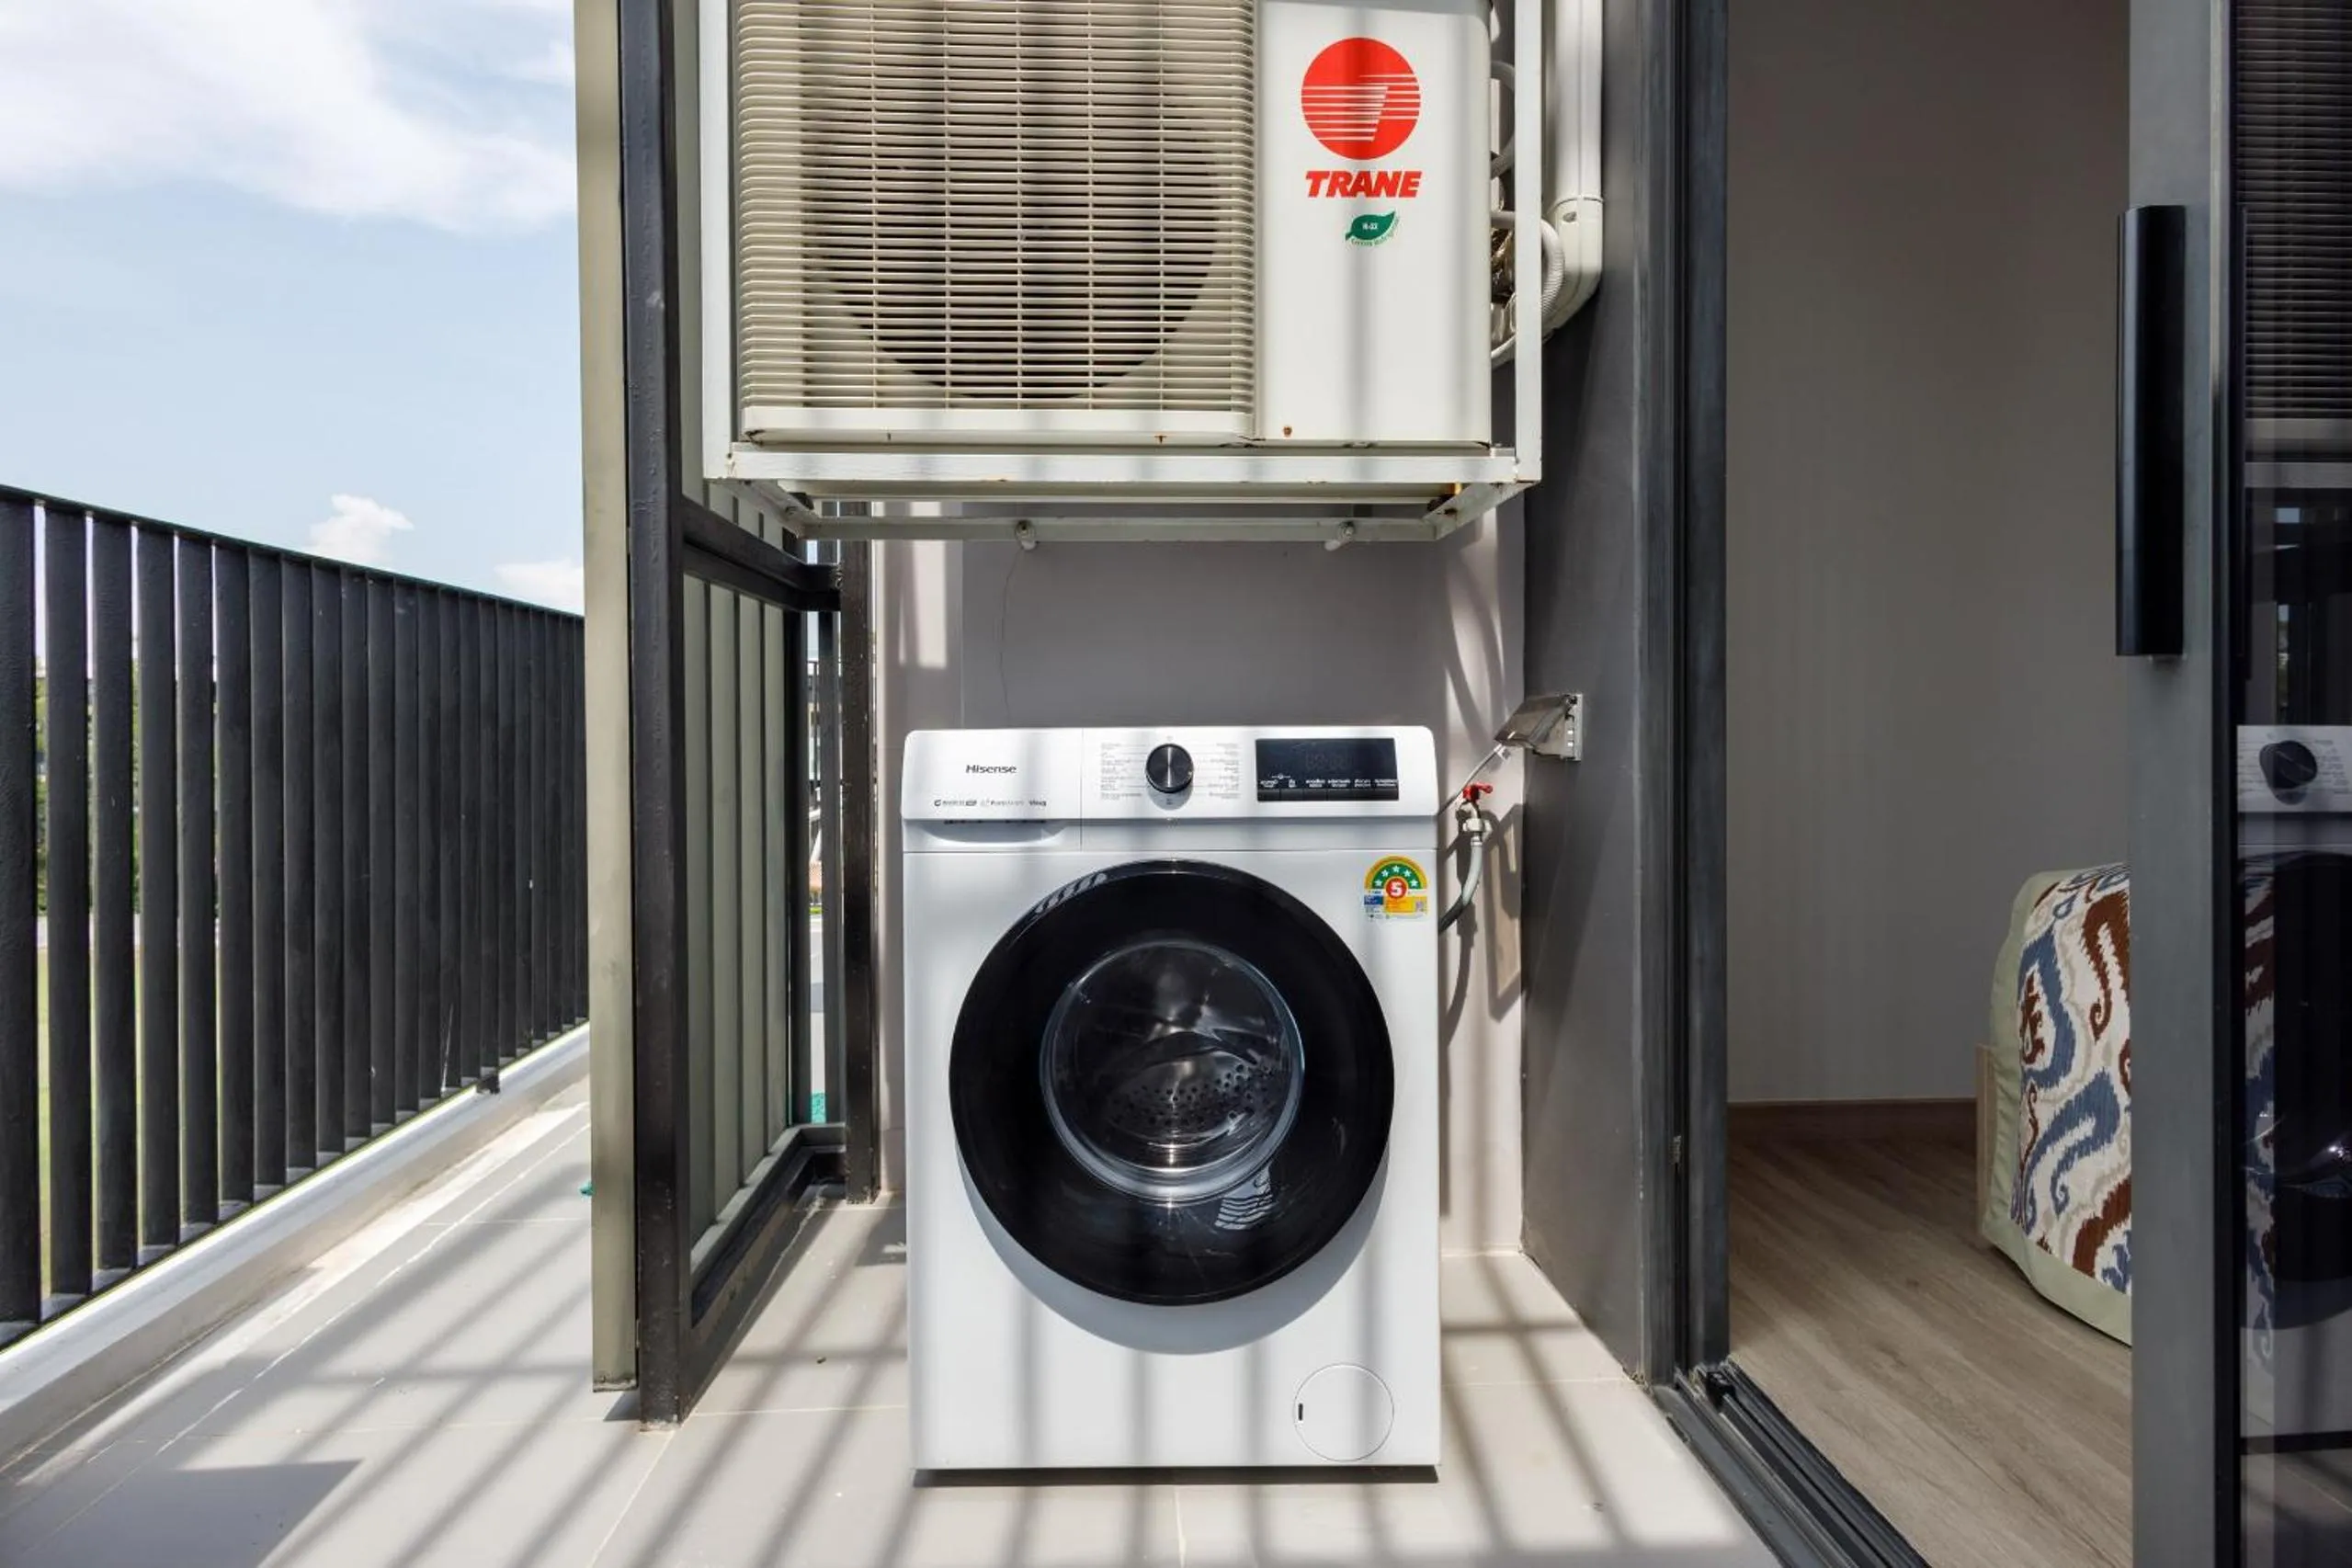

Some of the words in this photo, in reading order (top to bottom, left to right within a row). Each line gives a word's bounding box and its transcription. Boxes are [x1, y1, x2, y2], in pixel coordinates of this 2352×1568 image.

[1305, 170, 1422, 198] TRANE
[965, 765, 1017, 773] Hisense
[1390, 880, 1403, 896] 5
